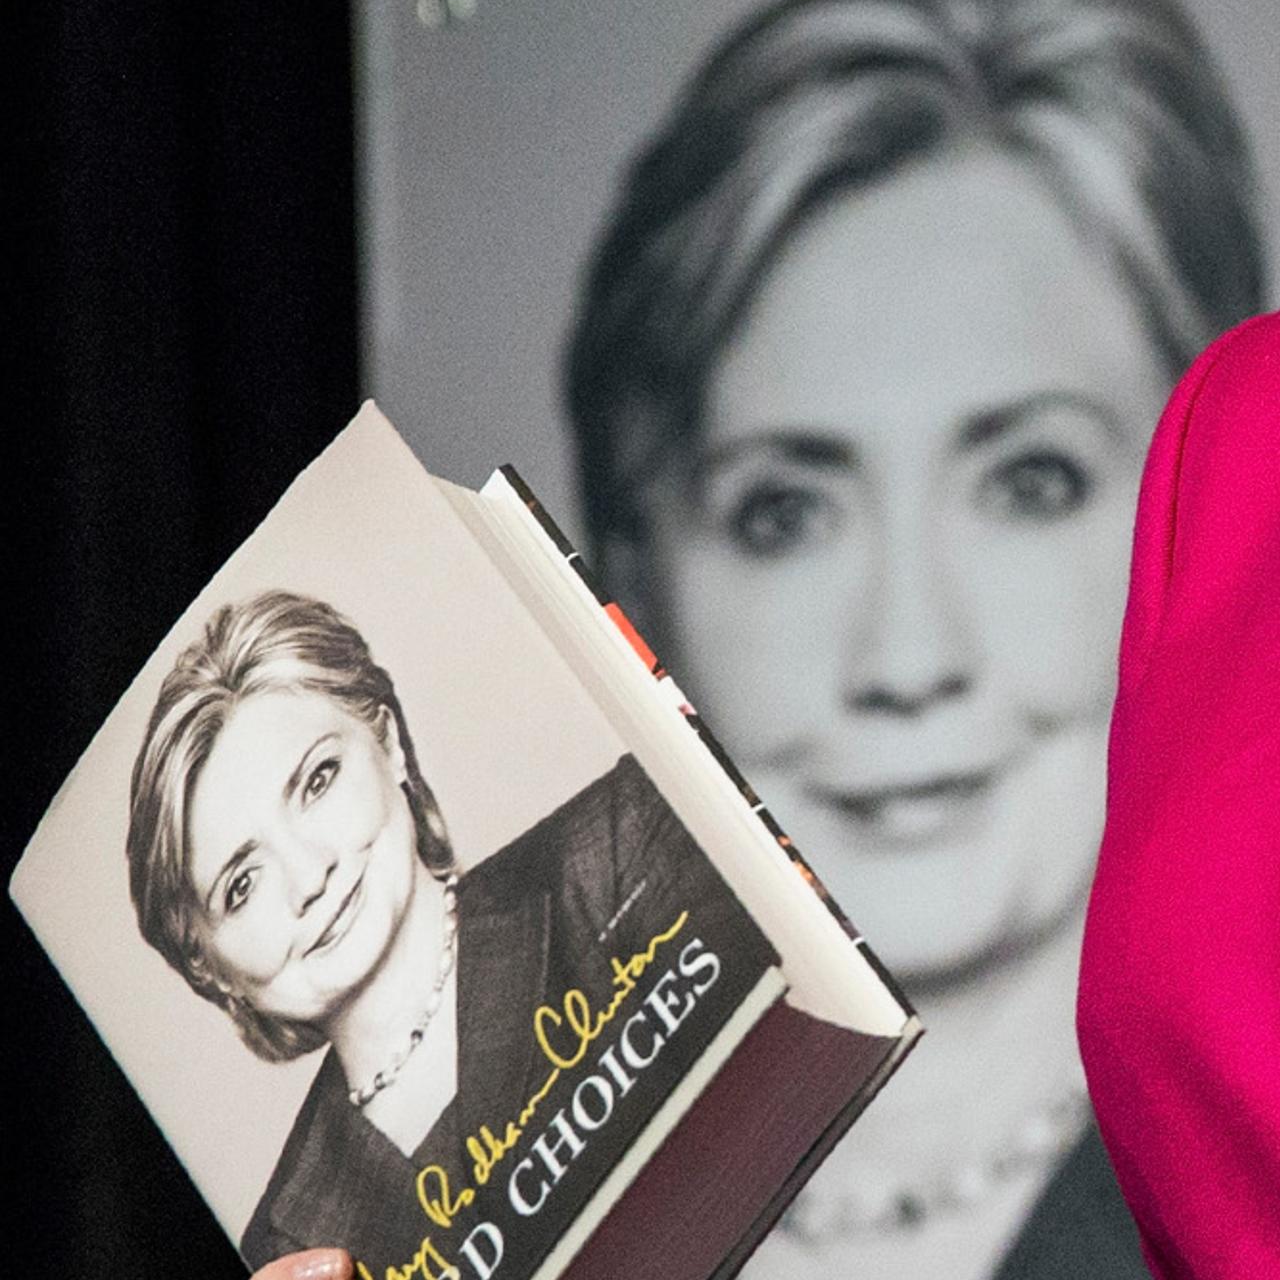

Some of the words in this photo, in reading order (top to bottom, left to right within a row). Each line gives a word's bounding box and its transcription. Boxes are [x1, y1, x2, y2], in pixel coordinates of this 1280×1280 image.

[415, 1067, 560, 1228] Rodham
[533, 910, 689, 1069] Clinton
[506, 937, 722, 1217] CHOICES
